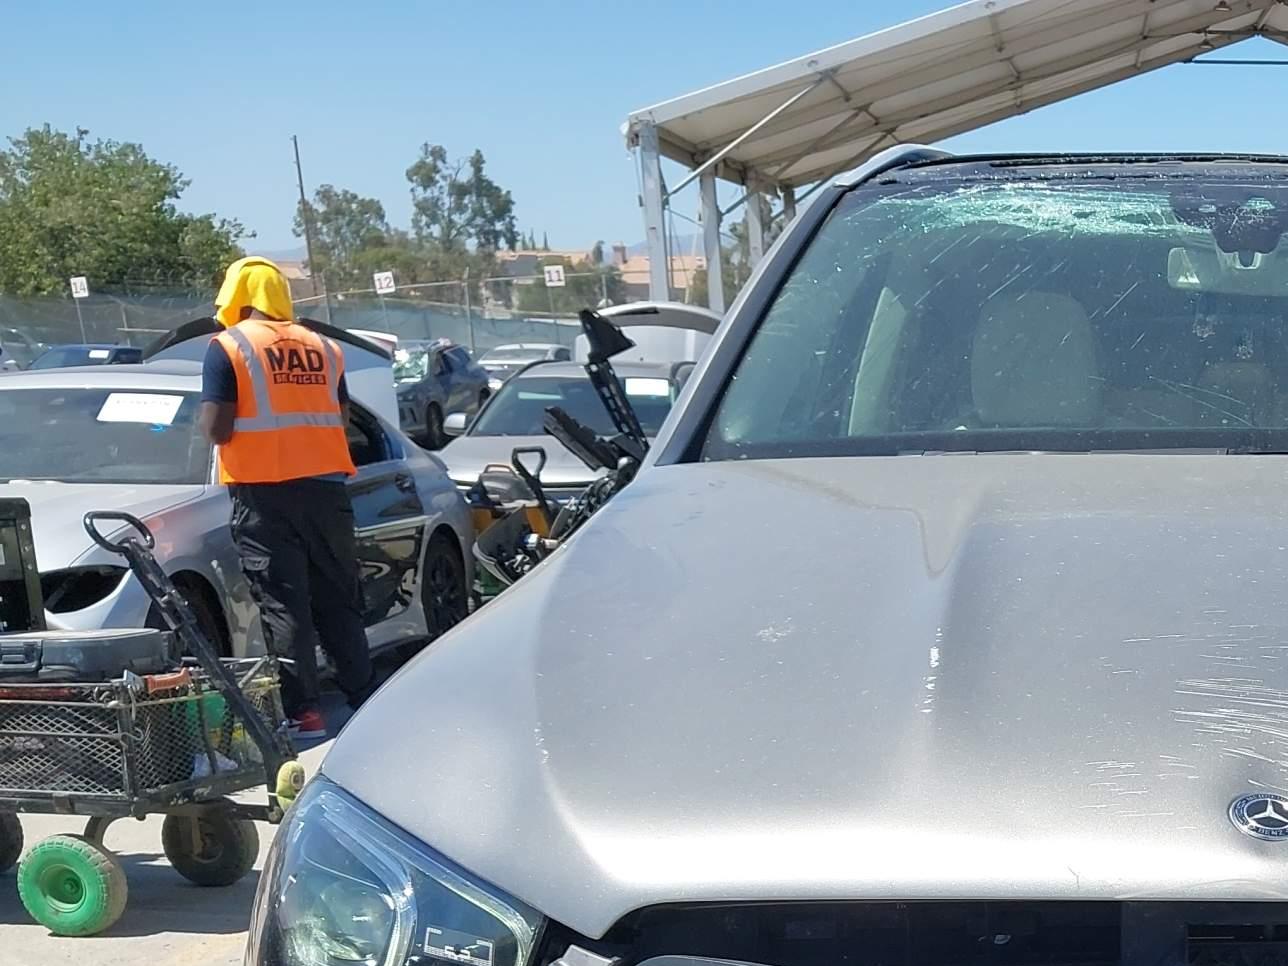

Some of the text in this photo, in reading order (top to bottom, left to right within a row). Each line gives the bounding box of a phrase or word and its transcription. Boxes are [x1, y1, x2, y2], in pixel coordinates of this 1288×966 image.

[376, 276, 393, 290] 12
[546, 270, 562, 283] 11
[72, 281, 87, 294] 14
[264, 347, 324, 372] MAD
